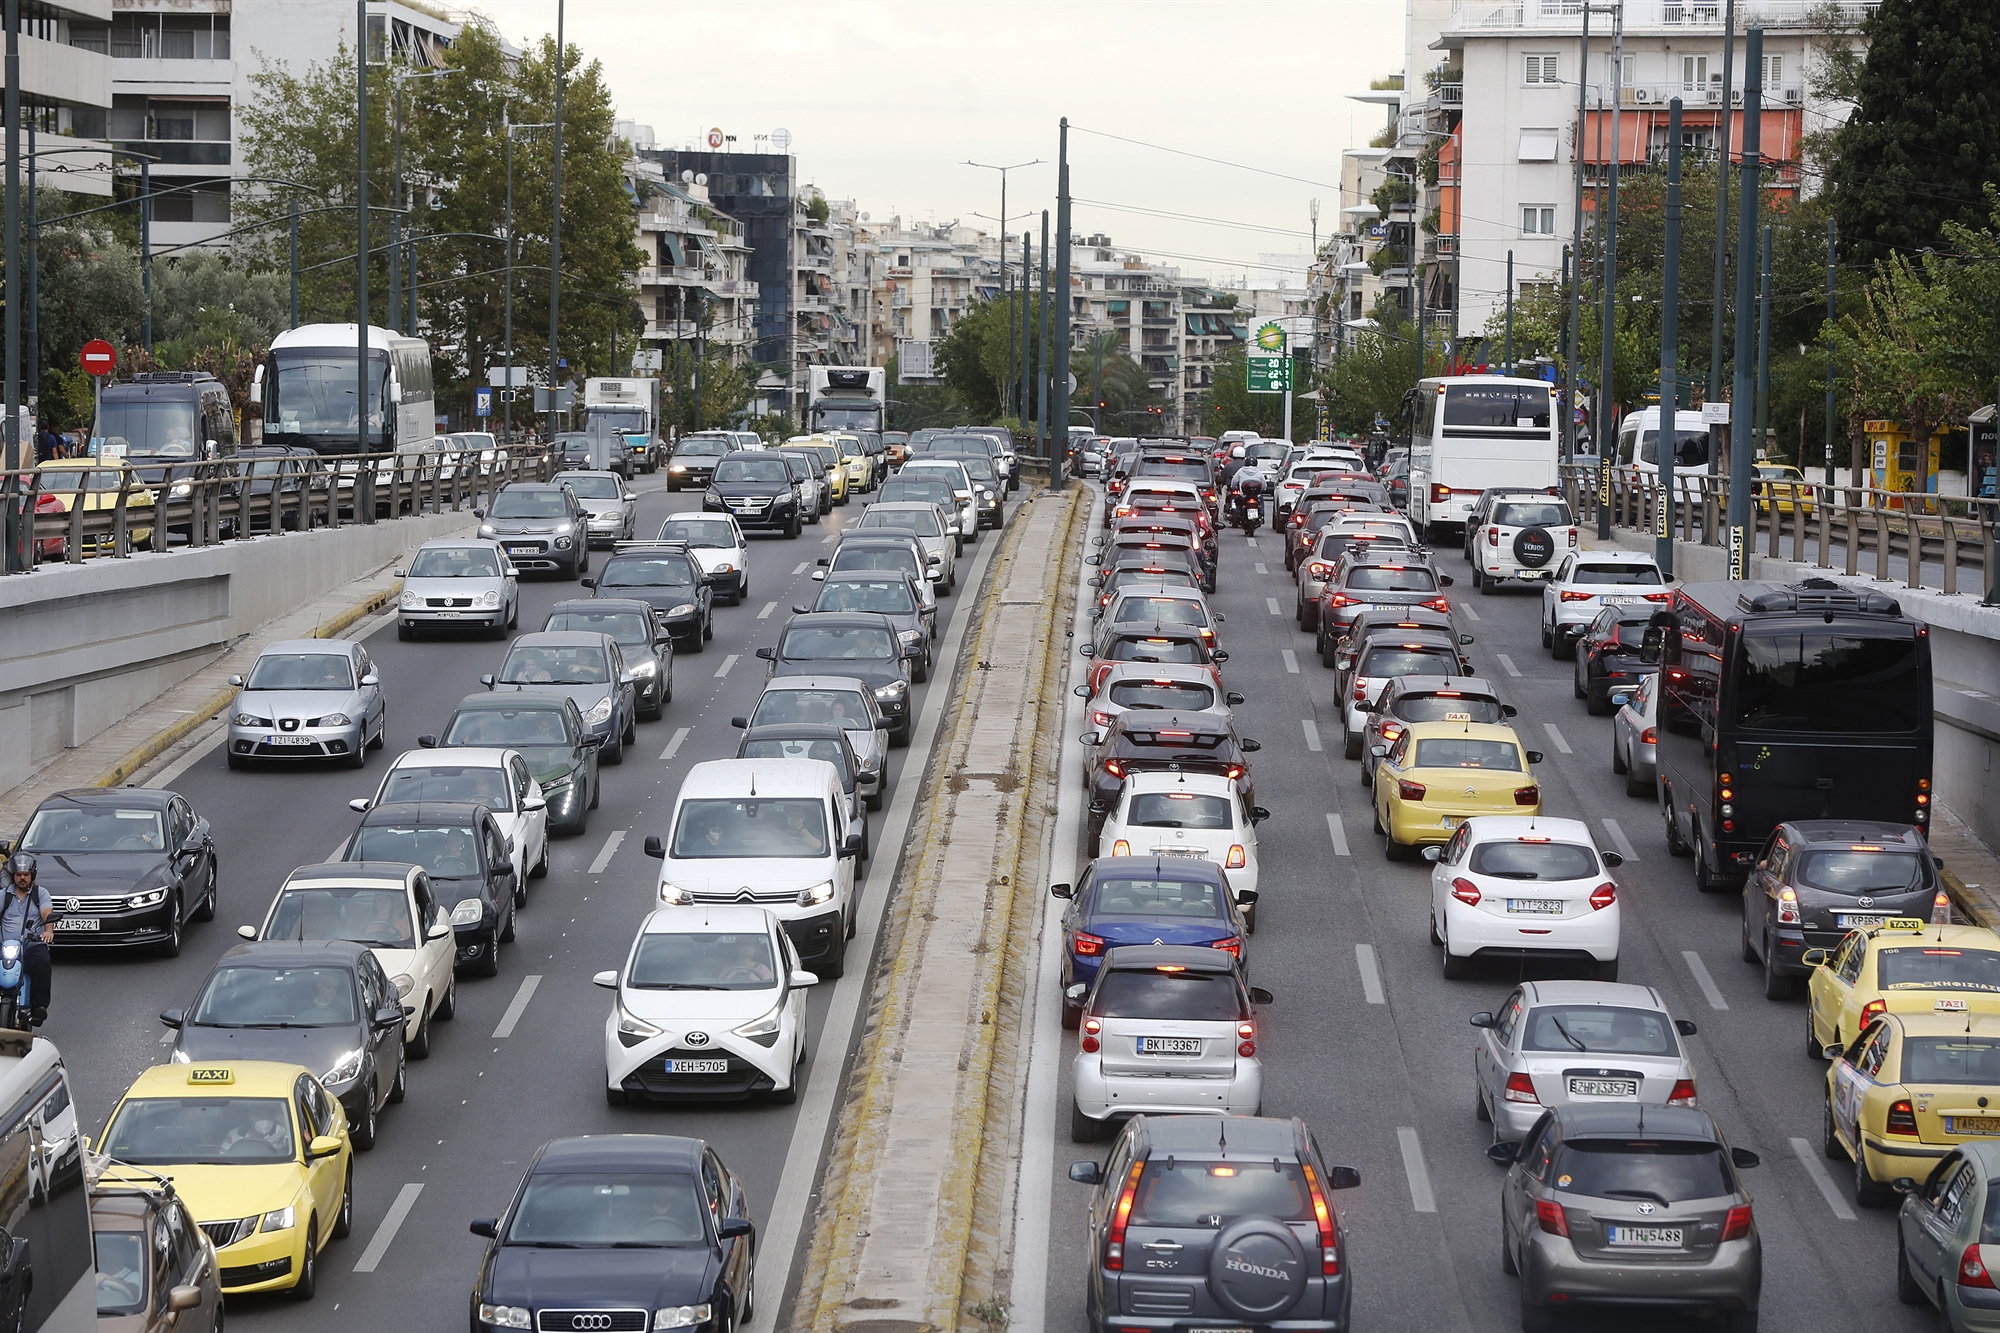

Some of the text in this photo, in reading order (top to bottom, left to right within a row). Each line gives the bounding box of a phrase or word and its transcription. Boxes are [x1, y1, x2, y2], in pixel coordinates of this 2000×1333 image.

[1600, 458, 1609, 504] tzaba.gr
[1657, 483, 1666, 535] tzaba.gr
[1523, 542, 1545, 551] TERIOS
[1731, 528, 1742, 580] zaba.gr
[1847, 916, 1886, 926] IKP-651
[1891, 921, 1918, 929] TAXI
[1933, 980, 1997, 992] ΚΗΦΙΣΙΑΣ
[1939, 1000, 1964, 1008] ΤΑΞΙ
[194, 1070, 228, 1079] TAXI
[1956, 1117, 2000, 1130] TAB-527
[1225, 1259, 1290, 1281] HONDA
